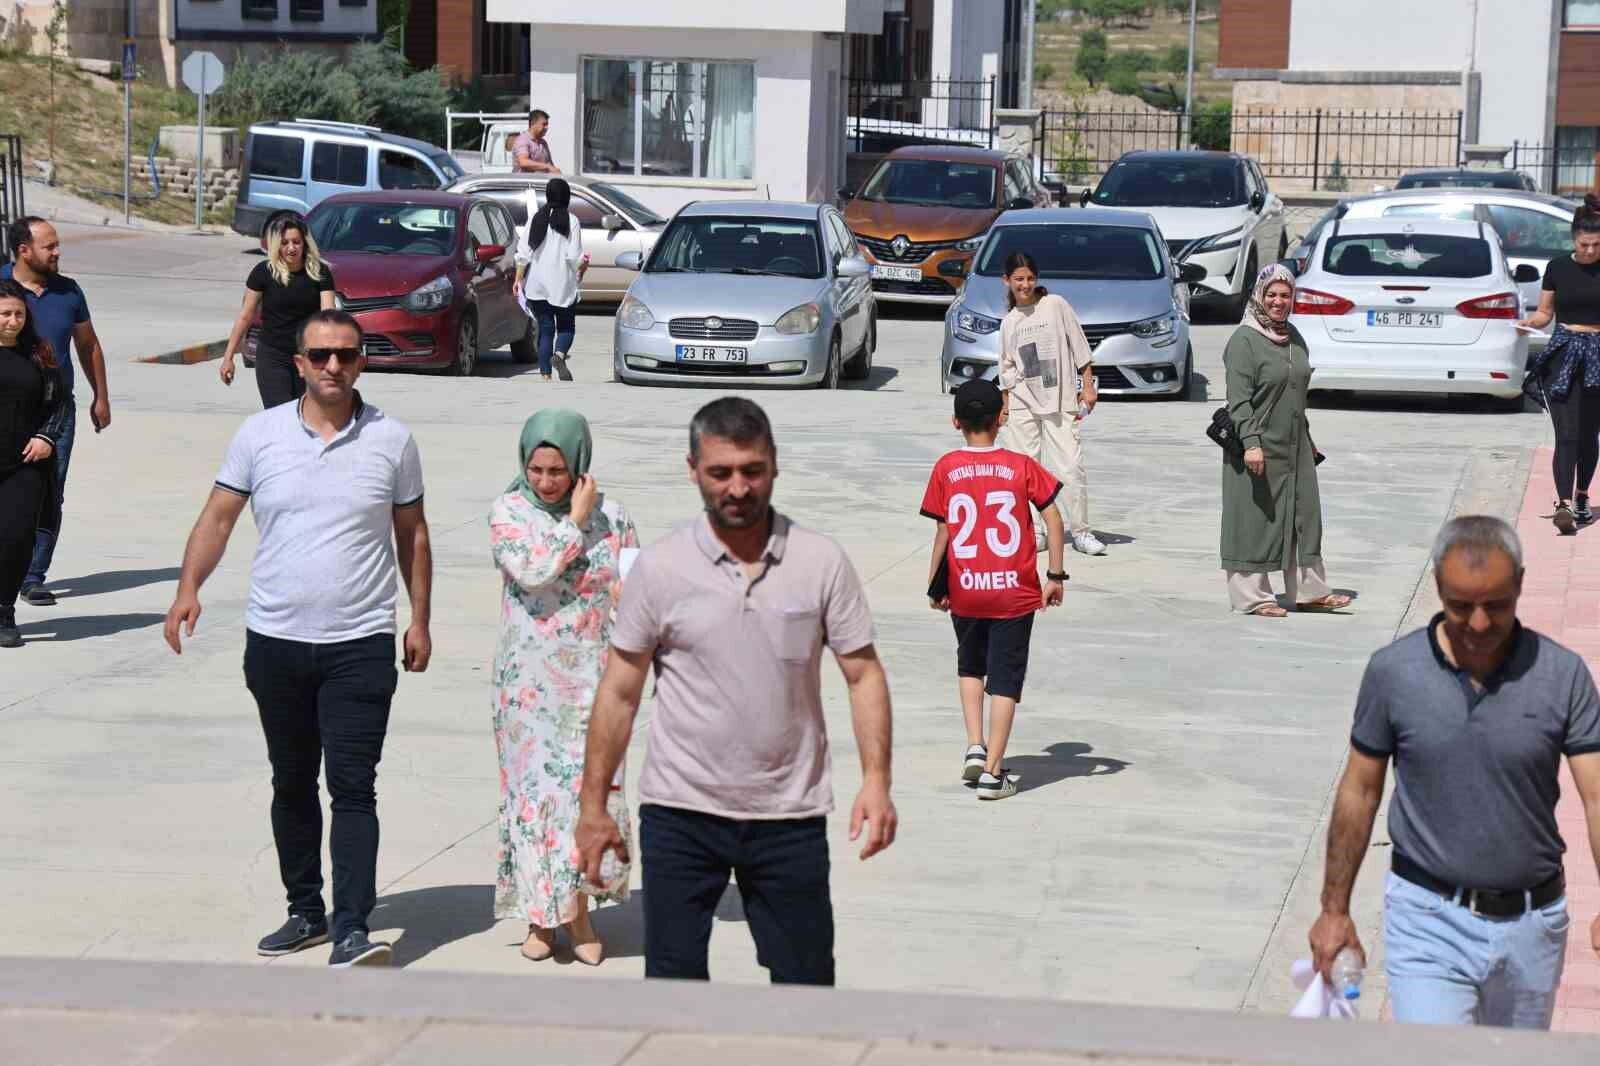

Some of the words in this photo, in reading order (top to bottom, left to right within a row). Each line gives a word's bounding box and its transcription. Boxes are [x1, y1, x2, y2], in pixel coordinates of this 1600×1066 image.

[1376, 312, 1389, 324] 46
[1419, 313, 1439, 326] 241
[683, 348, 696, 359] 23
[702, 348, 715, 360] FR
[725, 349, 744, 361] 753
[948, 490, 1021, 559] 23
[960, 567, 1020, 590] ÖMER
